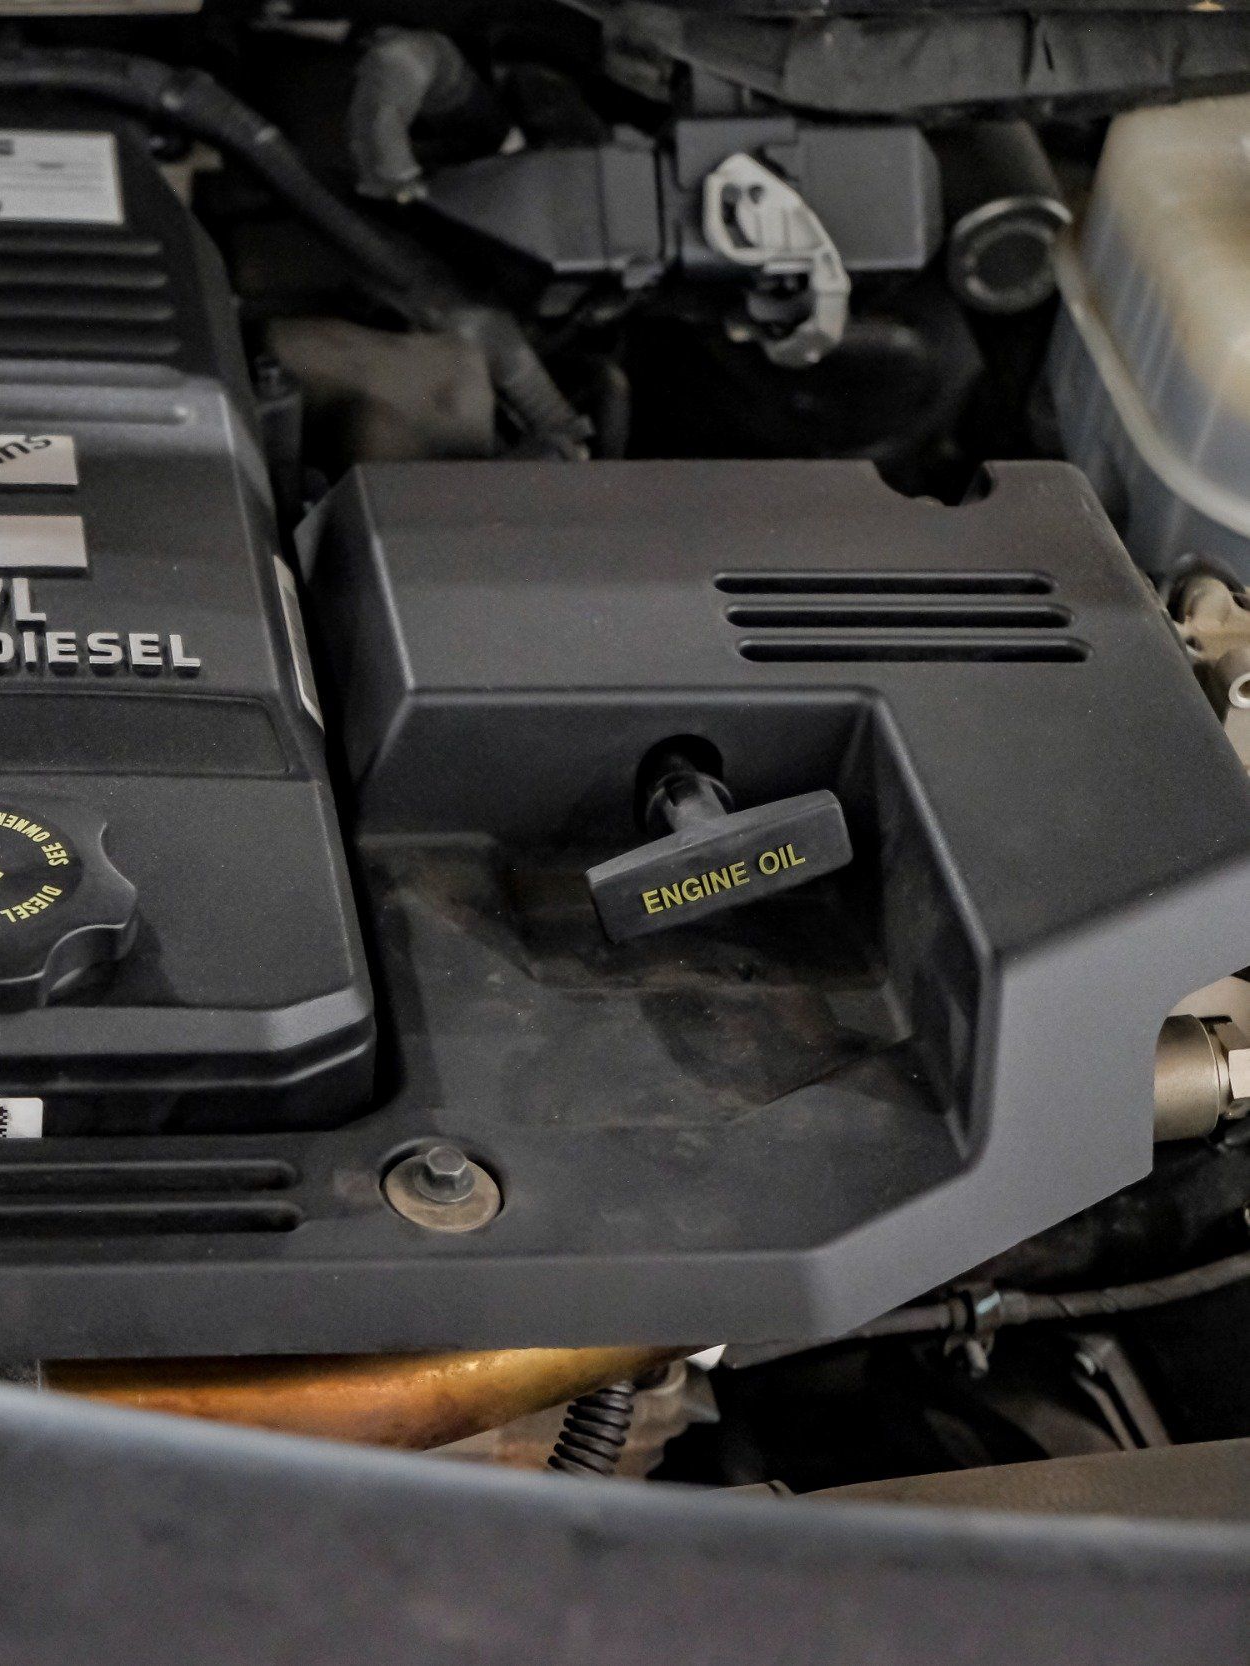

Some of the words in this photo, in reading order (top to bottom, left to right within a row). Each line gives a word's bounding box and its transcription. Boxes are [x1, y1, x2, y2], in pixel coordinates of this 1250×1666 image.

[41, 842, 69, 867] SEE
[641, 861, 750, 914] ENGINE
[758, 843, 806, 876] OIL
[0, 884, 62, 923] DIESEL
